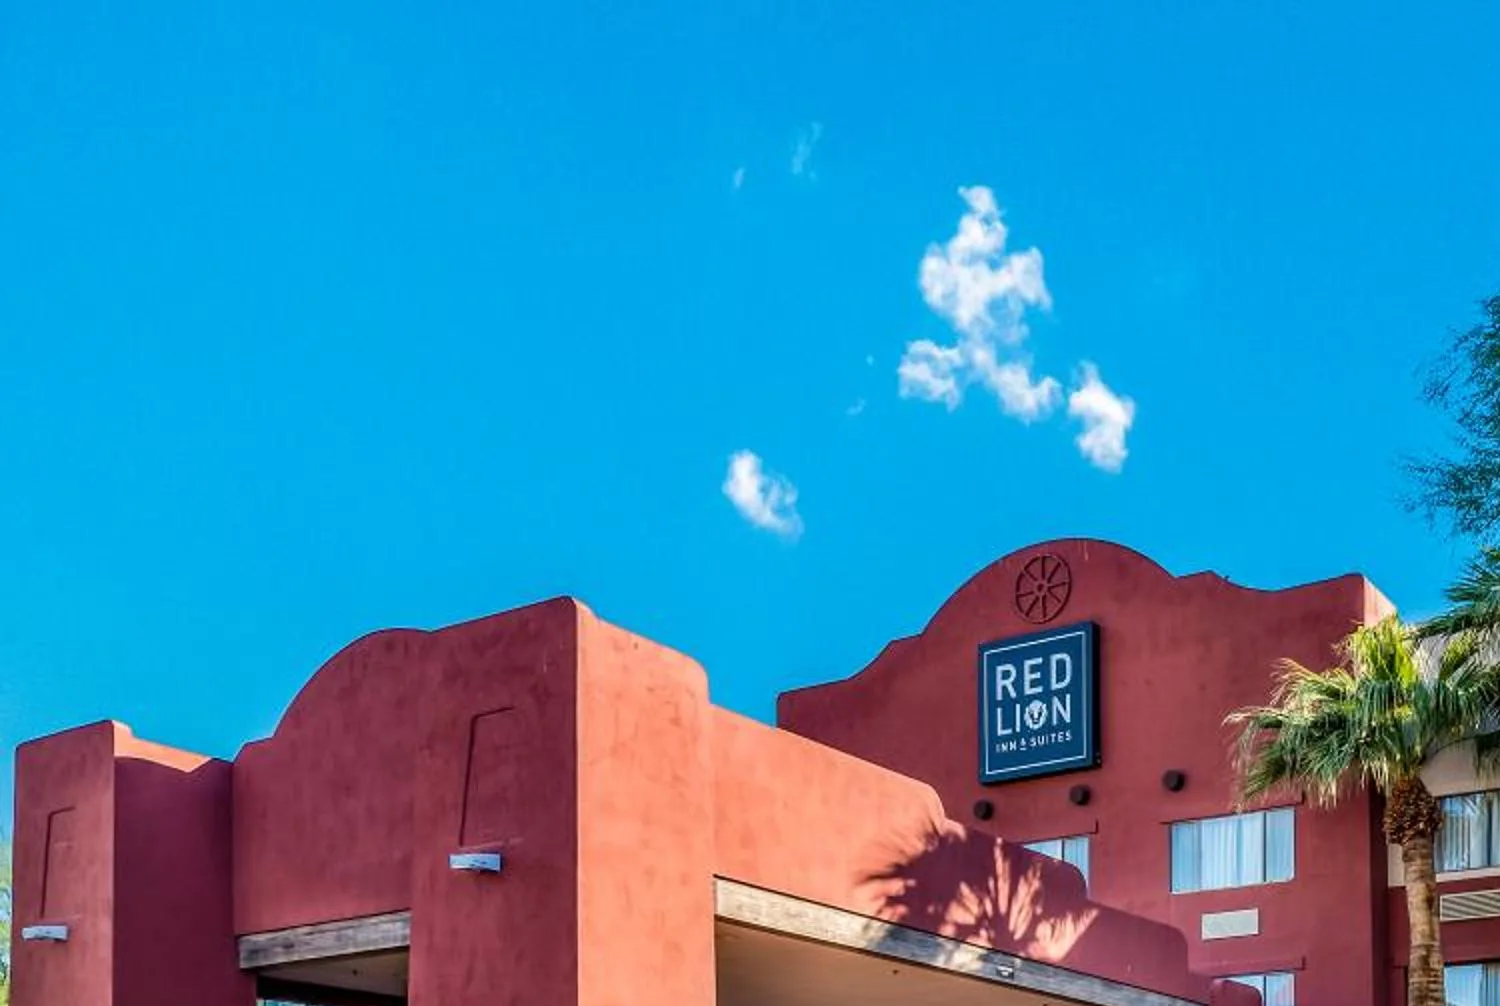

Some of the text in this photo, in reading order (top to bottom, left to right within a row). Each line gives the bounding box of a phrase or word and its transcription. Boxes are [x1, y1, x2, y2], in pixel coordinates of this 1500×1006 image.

[996, 652, 1072, 701] RED
[996, 693, 1072, 737] LION
[995, 740, 1017, 753] INN
[1030, 730, 1072, 748] SUITES
